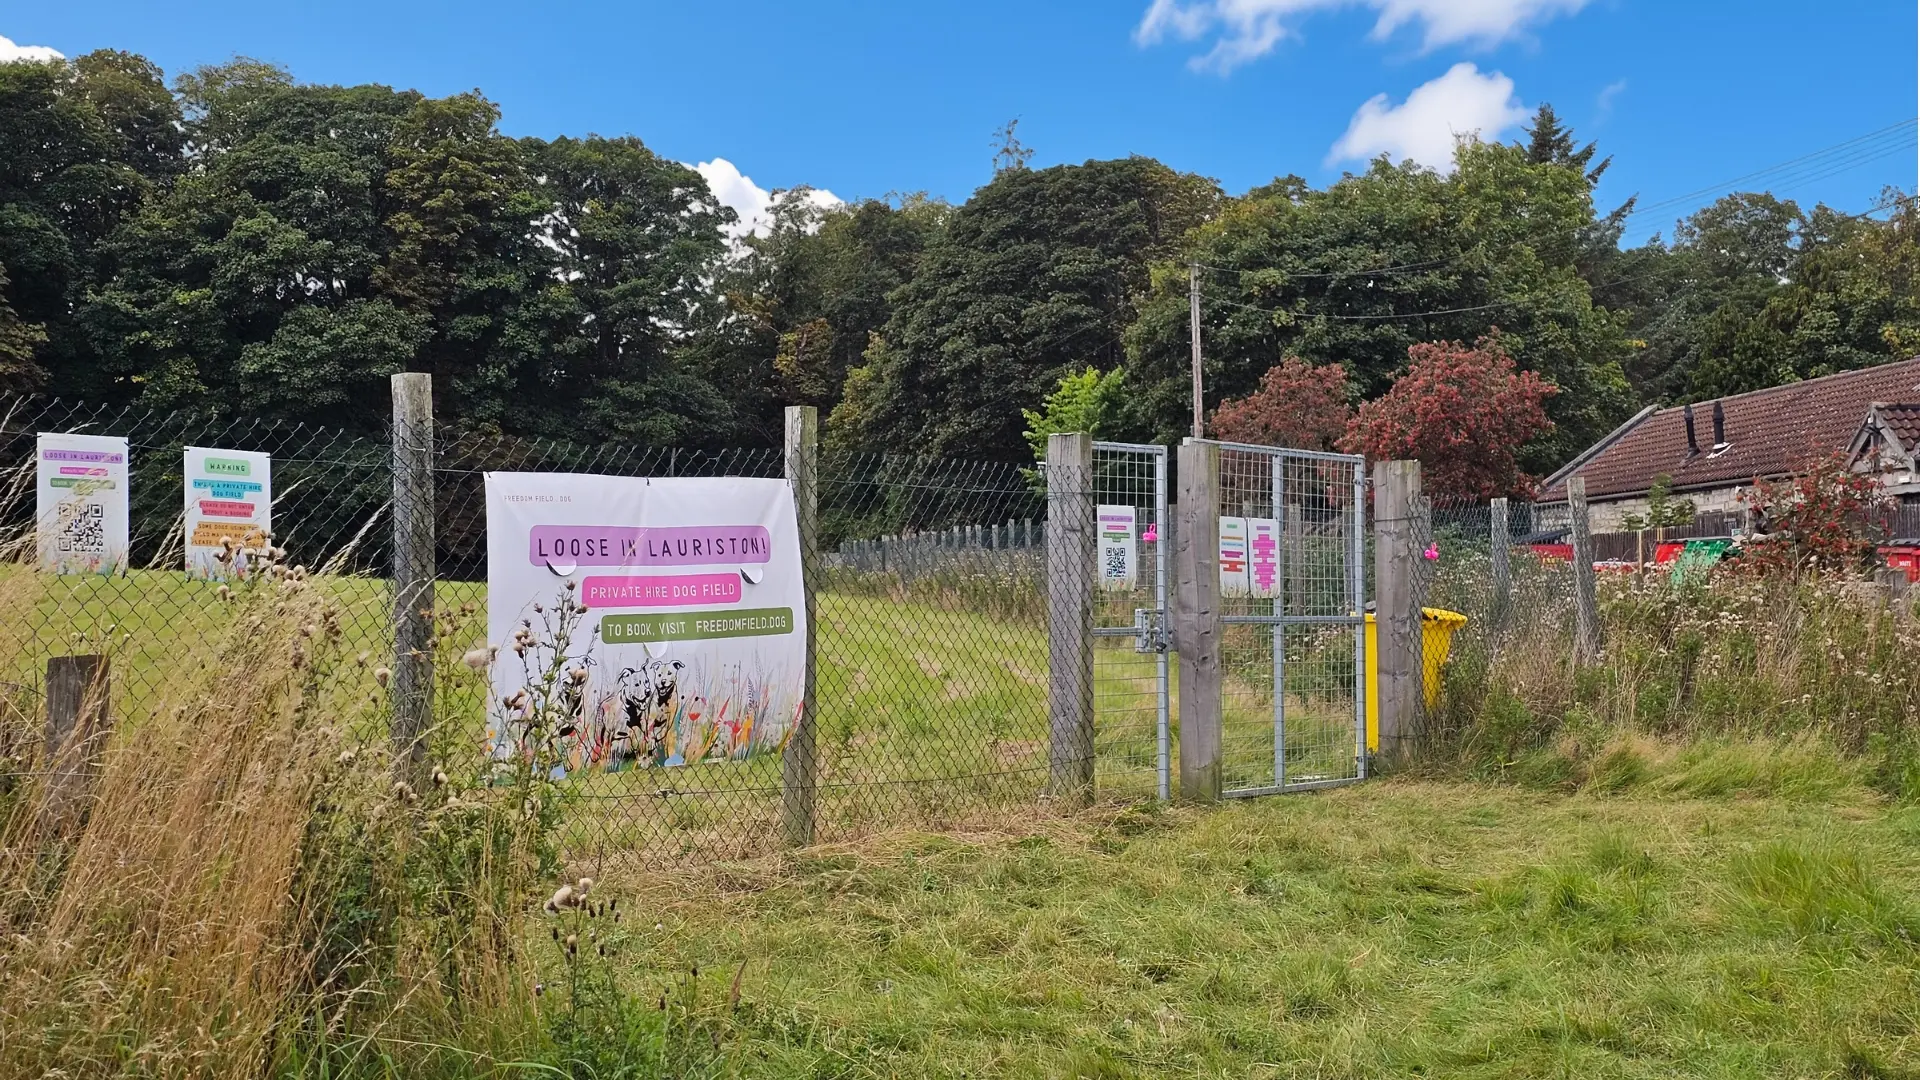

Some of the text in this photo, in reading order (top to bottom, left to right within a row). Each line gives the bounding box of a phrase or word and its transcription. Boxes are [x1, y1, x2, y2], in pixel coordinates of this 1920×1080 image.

[210, 464, 246, 472] WARNING
[538, 538, 766, 557] LOOSE IN LAURISTON!
[590, 583, 735, 599] PRIVATE HIRE DOG FIELD
[608, 616, 786, 637] TO BOOK, VISIT FREEDOMFIELD.DOG
